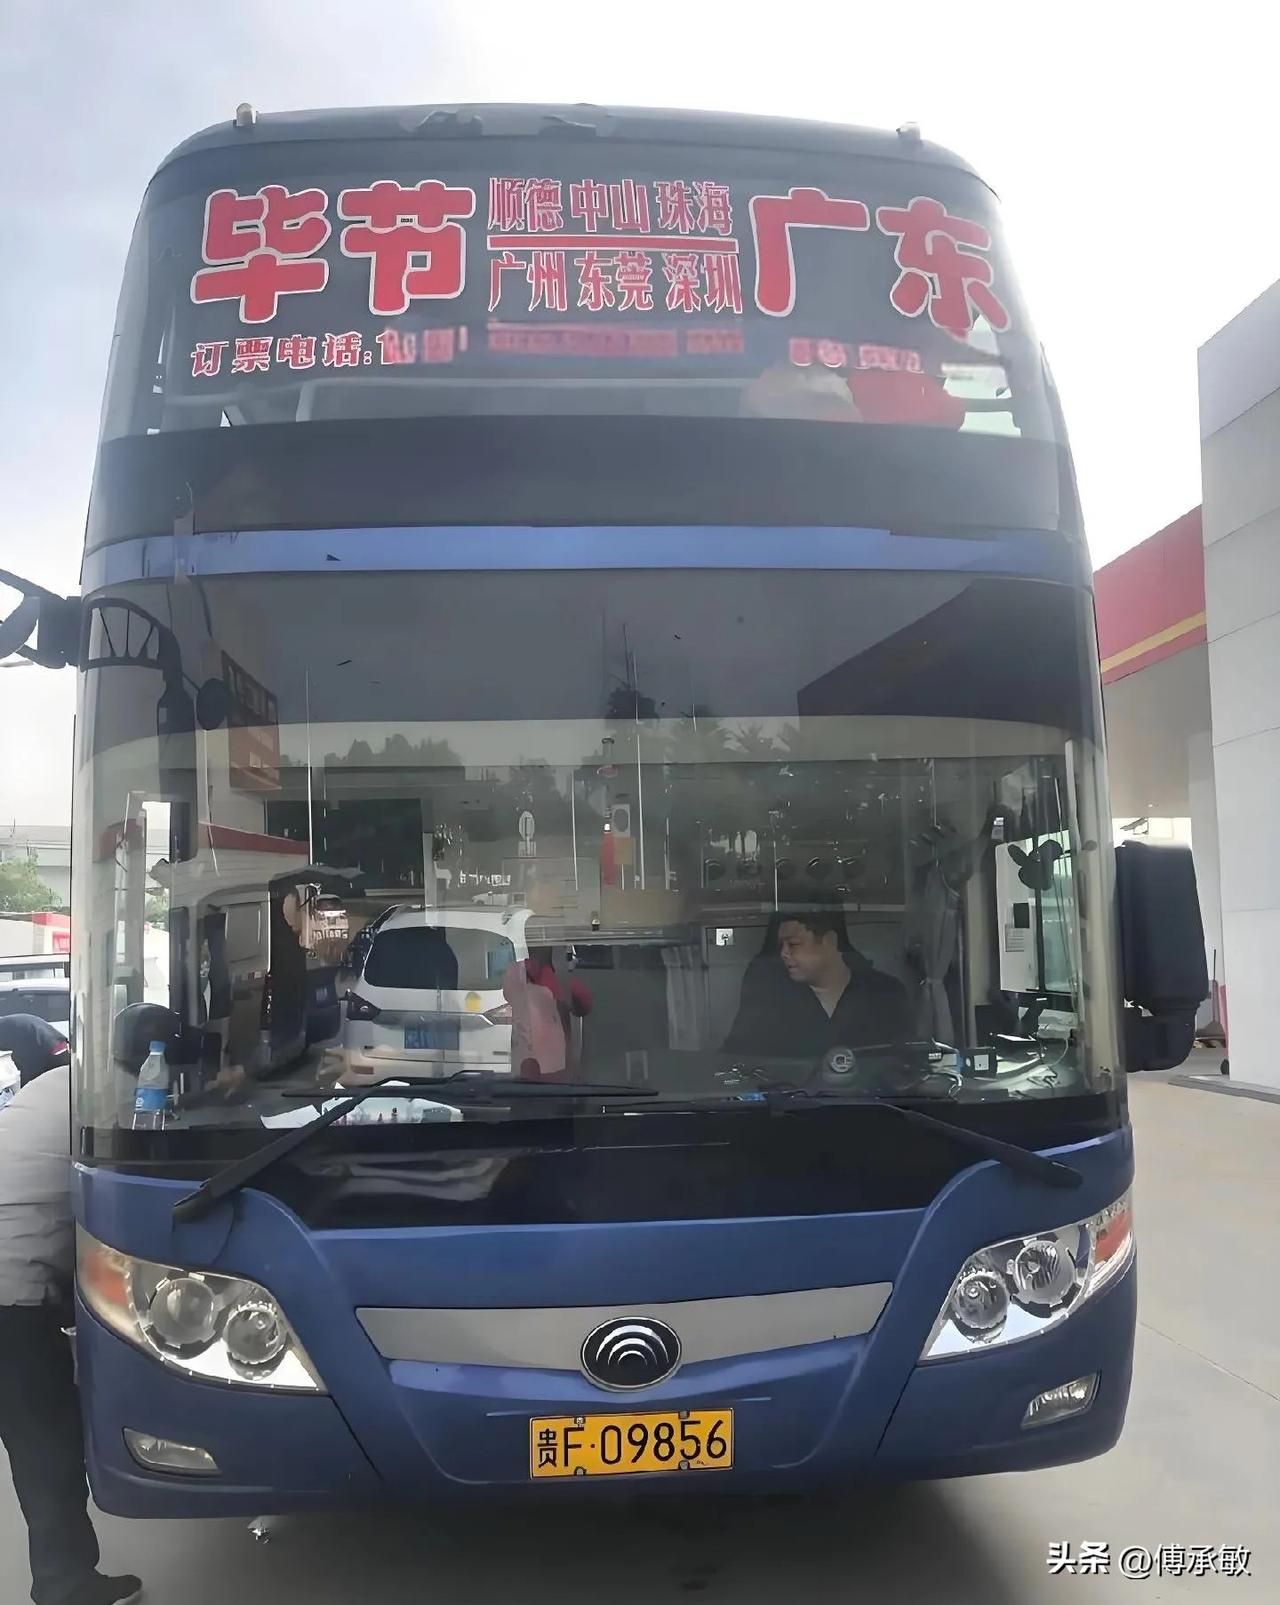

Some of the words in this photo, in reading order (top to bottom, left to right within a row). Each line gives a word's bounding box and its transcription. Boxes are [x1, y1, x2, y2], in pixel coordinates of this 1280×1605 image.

[190, 180, 475, 323] 毕节
[487, 178, 563, 232] 顺德
[570, 179, 650, 232] 中山
[653, 180, 733, 235] 珠海
[488, 251, 567, 311] 广州
[574, 251, 654, 311] 东莞
[662, 252, 743, 313] 深圳
[749, 187, 1011, 341] 广东
